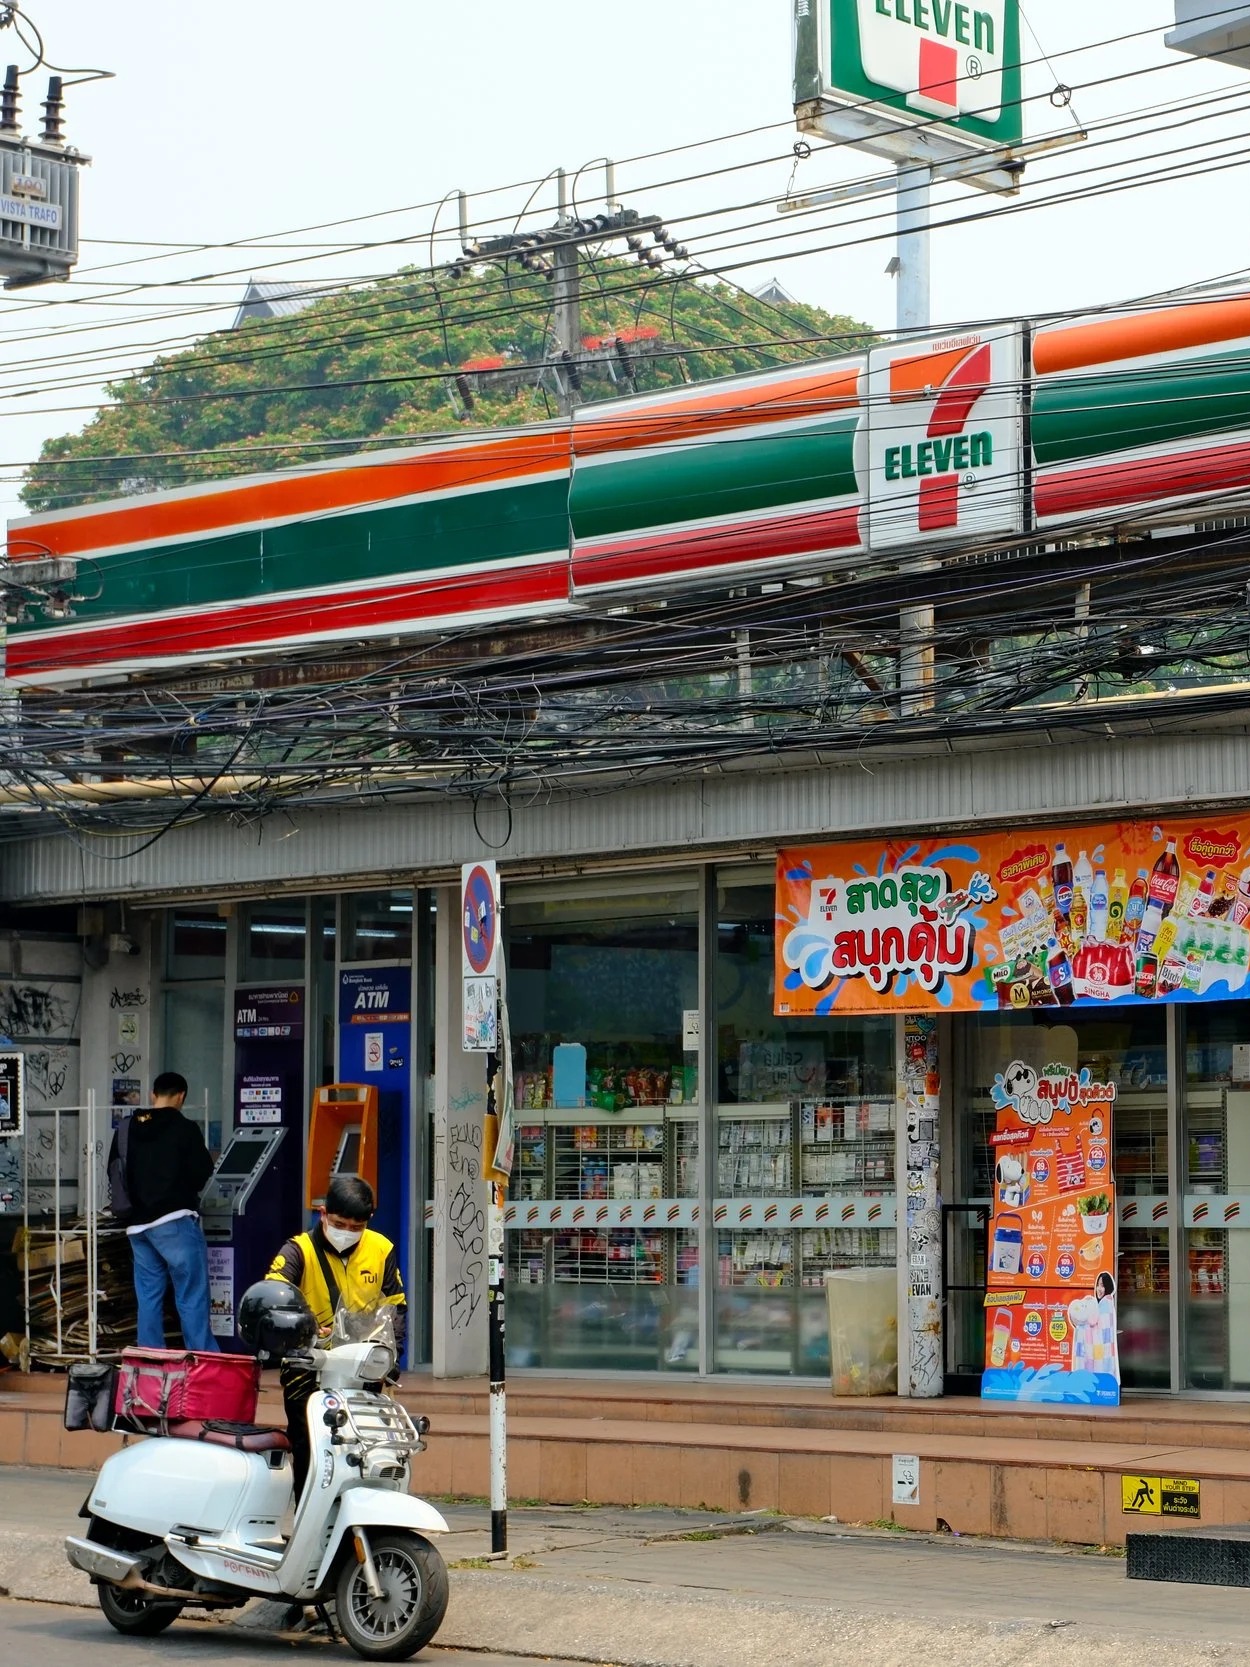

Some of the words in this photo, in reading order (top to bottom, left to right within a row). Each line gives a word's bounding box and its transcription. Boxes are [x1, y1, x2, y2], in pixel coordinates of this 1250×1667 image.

[29, 205, 57, 223] TRAFO
[832, 905, 966, 984] สนุกคุ้ม
[993, 970, 1010, 980] MILO
[1084, 986, 1110, 998] SINGHA
[354, 991, 390, 1009] ATM
[237, 1008, 256, 1024] ATM
[912, 1283, 932, 1296] EVAN
[1051, 1323, 1064, 1331] 499
